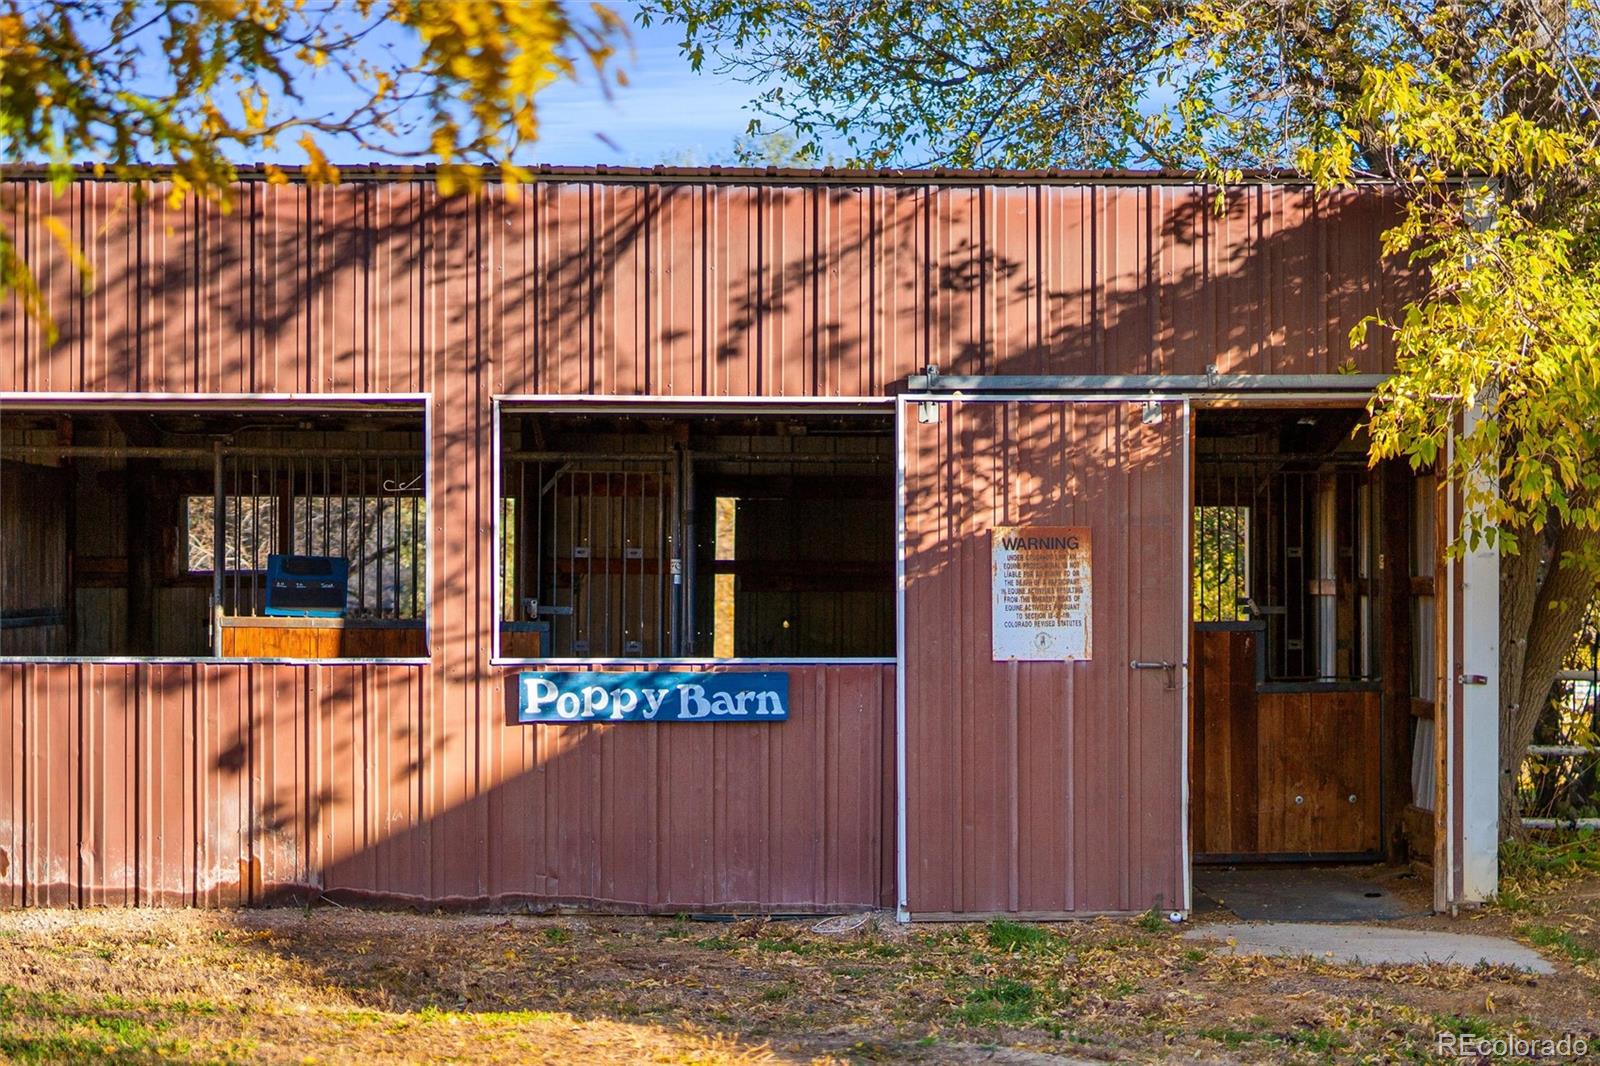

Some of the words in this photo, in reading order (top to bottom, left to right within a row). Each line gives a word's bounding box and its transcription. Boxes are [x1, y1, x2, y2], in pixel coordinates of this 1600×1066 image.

[1002, 536, 1079, 550] WARNING
[1004, 604, 1023, 612] EQUINE
[1034, 620, 1056, 628] REVISED
[1057, 620, 1082, 628] STATUTES
[524, 678, 669, 719] Poppy
[677, 684, 785, 718] Barn
